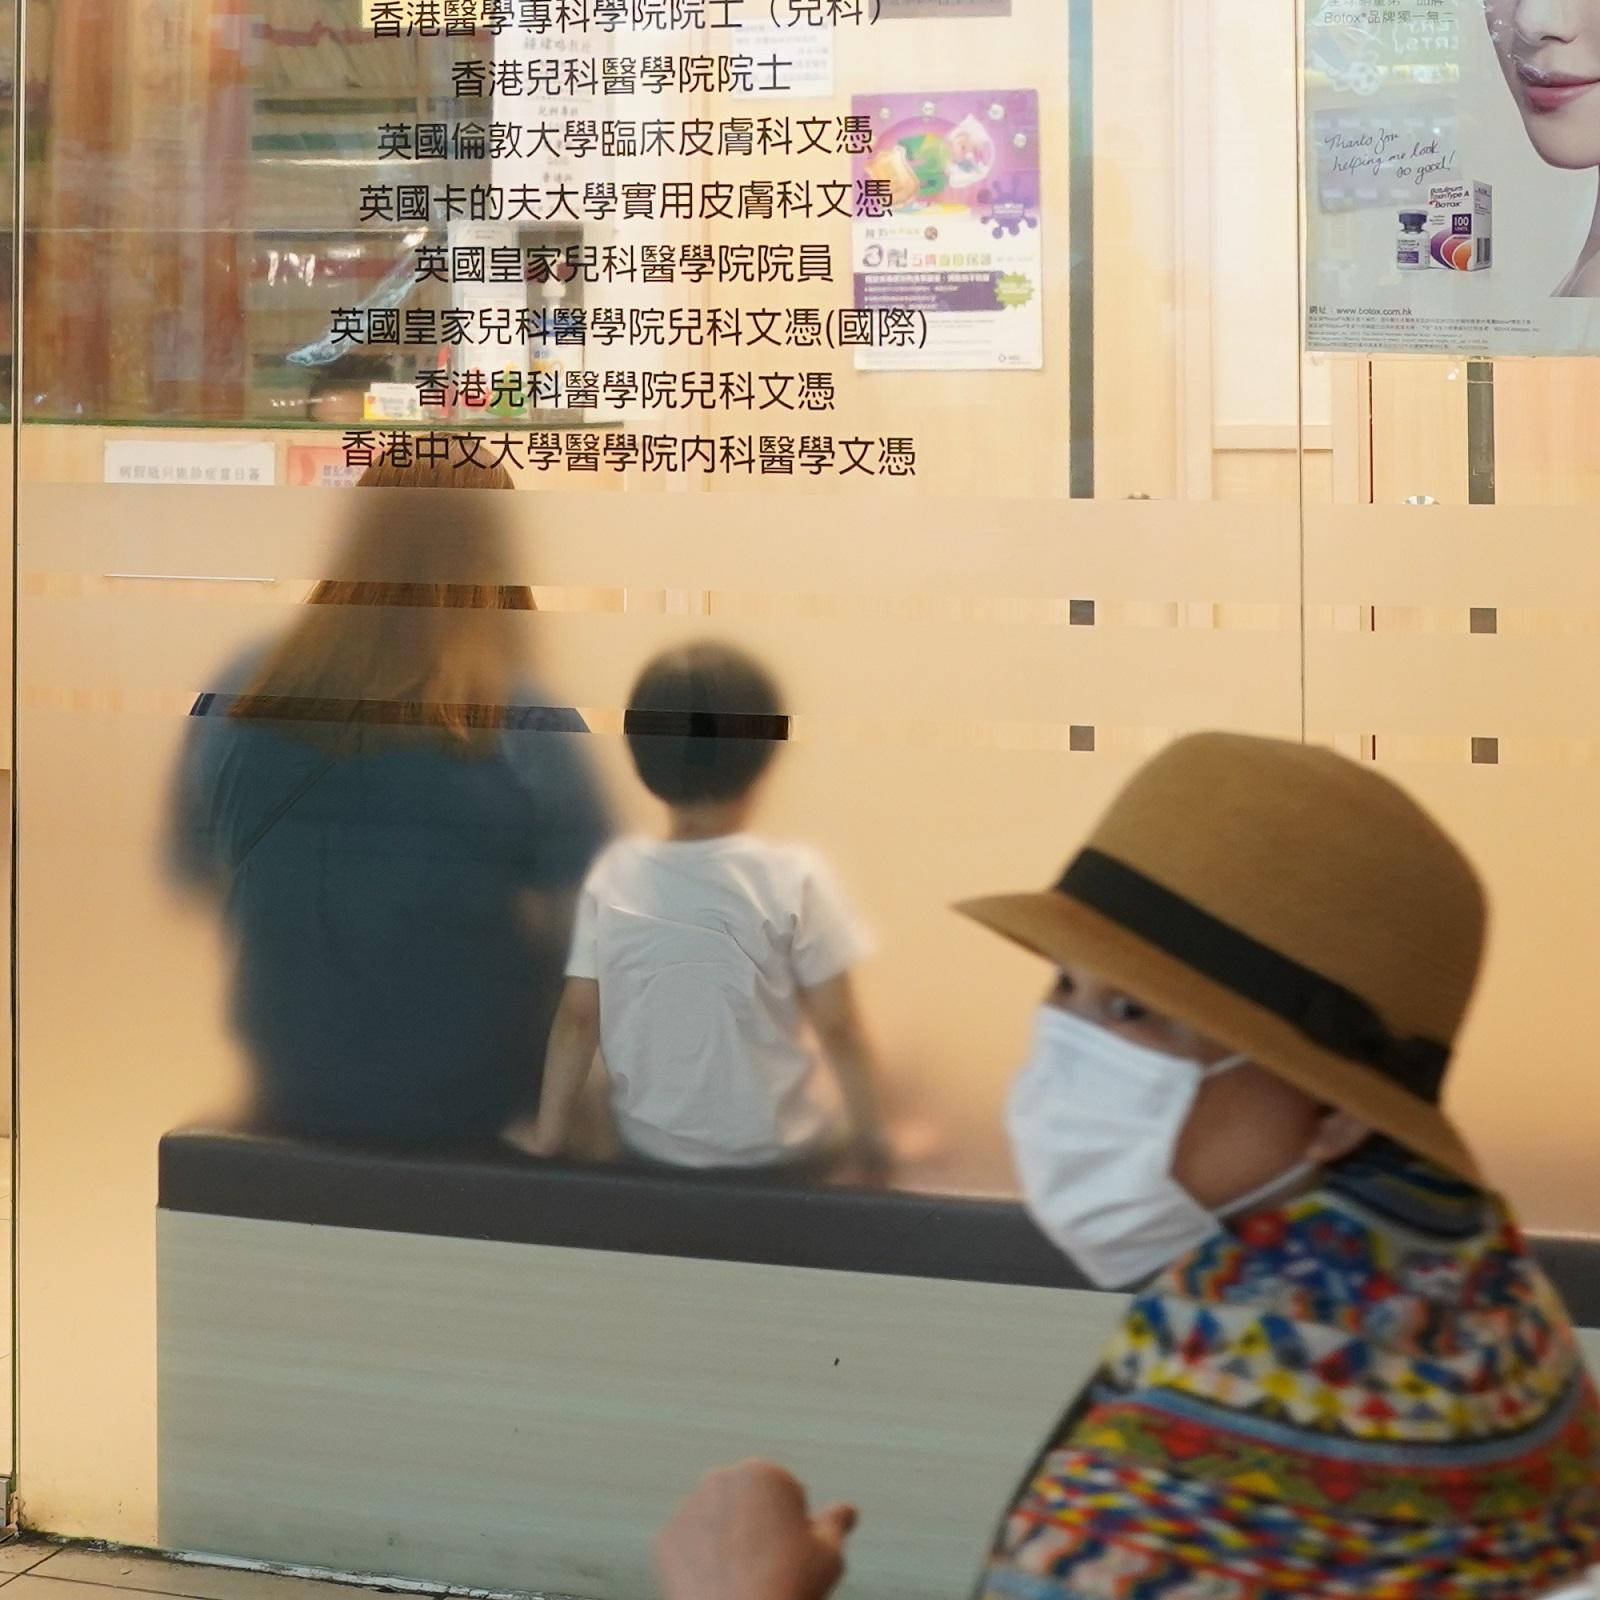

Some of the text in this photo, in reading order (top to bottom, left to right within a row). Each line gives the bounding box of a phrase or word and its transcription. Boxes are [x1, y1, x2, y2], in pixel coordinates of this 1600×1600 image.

[450, 54, 793, 101] 香港兒科醫學院院士
[376, 115, 873, 162] 英國倫敦大學臨床皮膚科文憑
[1333, 155, 1384, 176] helping
[1409, 140, 1441, 160] look
[1396, 150, 1456, 185] so good!
[358, 179, 894, 223] 英國卡的夫大學實用皮膚科文憑
[1454, 216, 1469, 226] 100
[413, 244, 834, 285] 英國皇家兒科醫學院院員
[414, 370, 836, 412] 香港兒科醫學院兒科文憑
